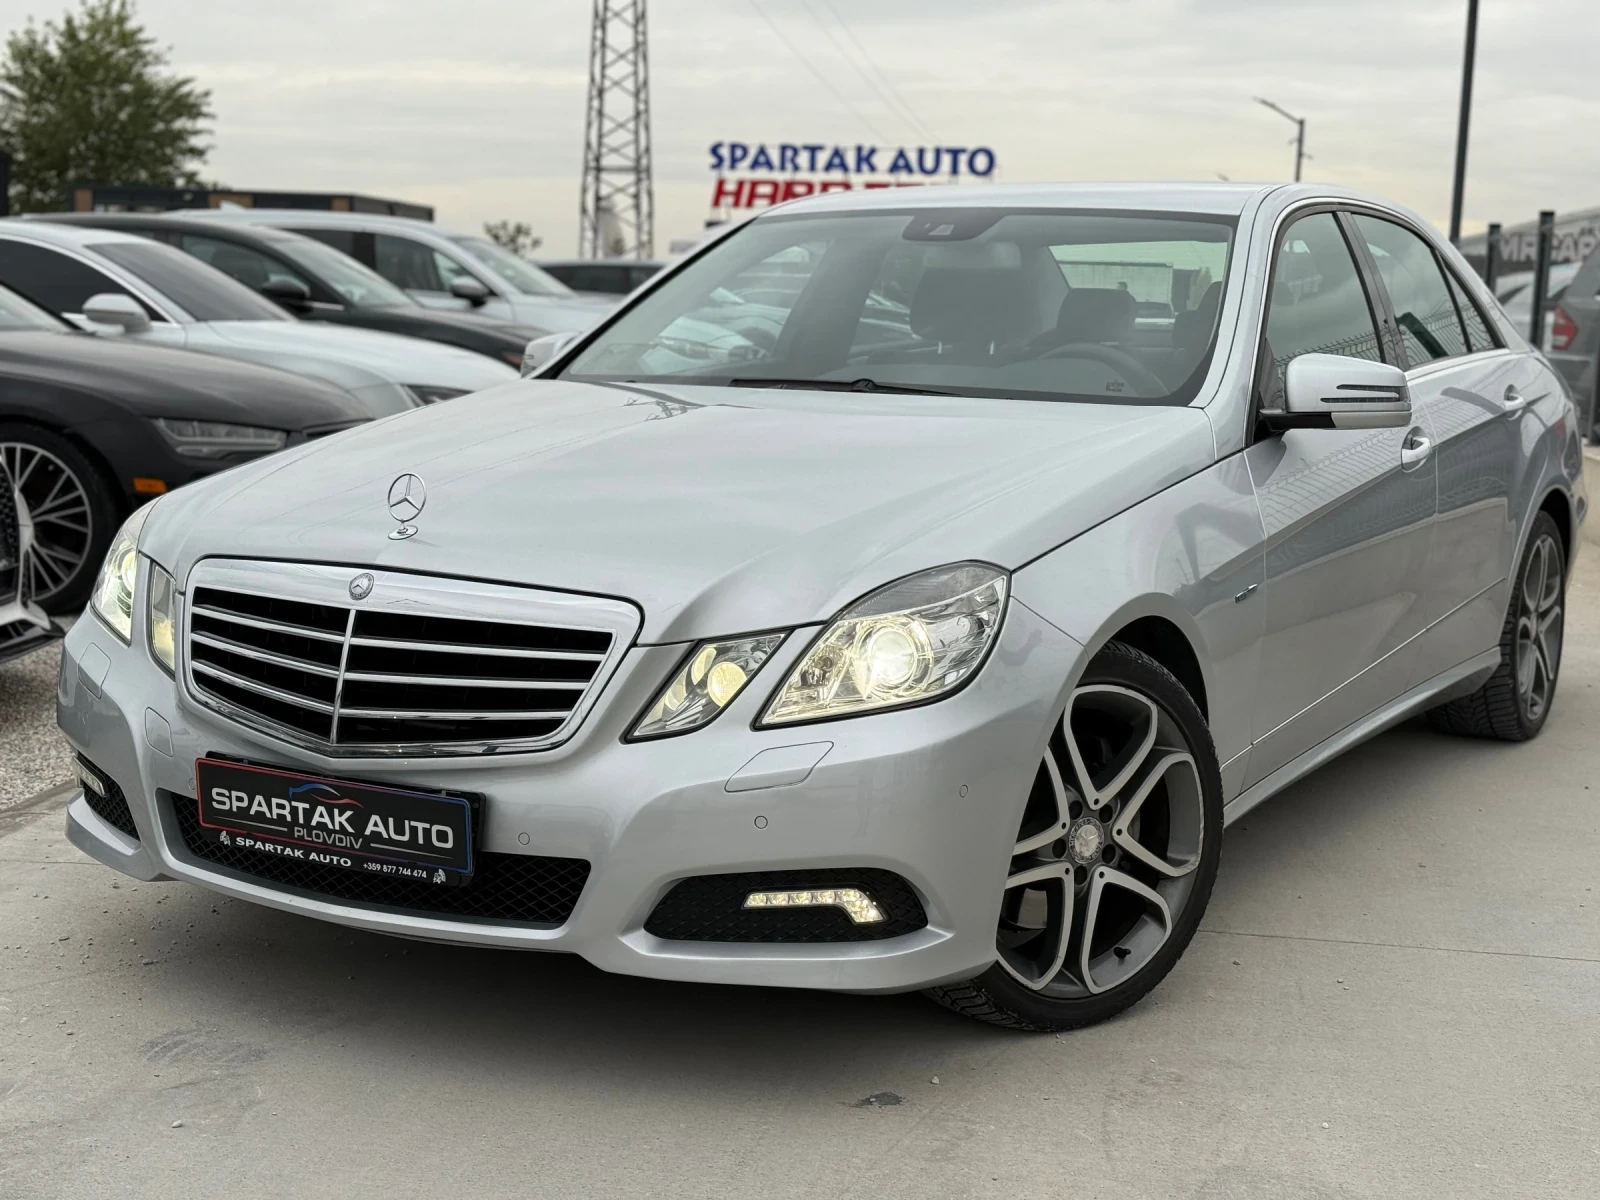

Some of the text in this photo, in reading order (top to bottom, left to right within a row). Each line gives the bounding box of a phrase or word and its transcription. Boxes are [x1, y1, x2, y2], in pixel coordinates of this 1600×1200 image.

[710, 142, 997, 177] SPARTAK AUTO
[211, 787, 454, 849] SPARTAK AUTO
[235, 837, 352, 867] SPARTAK AUTO
[293, 826, 363, 849] PLOVDIV
[363, 862, 427, 879] +359 877 744 474
